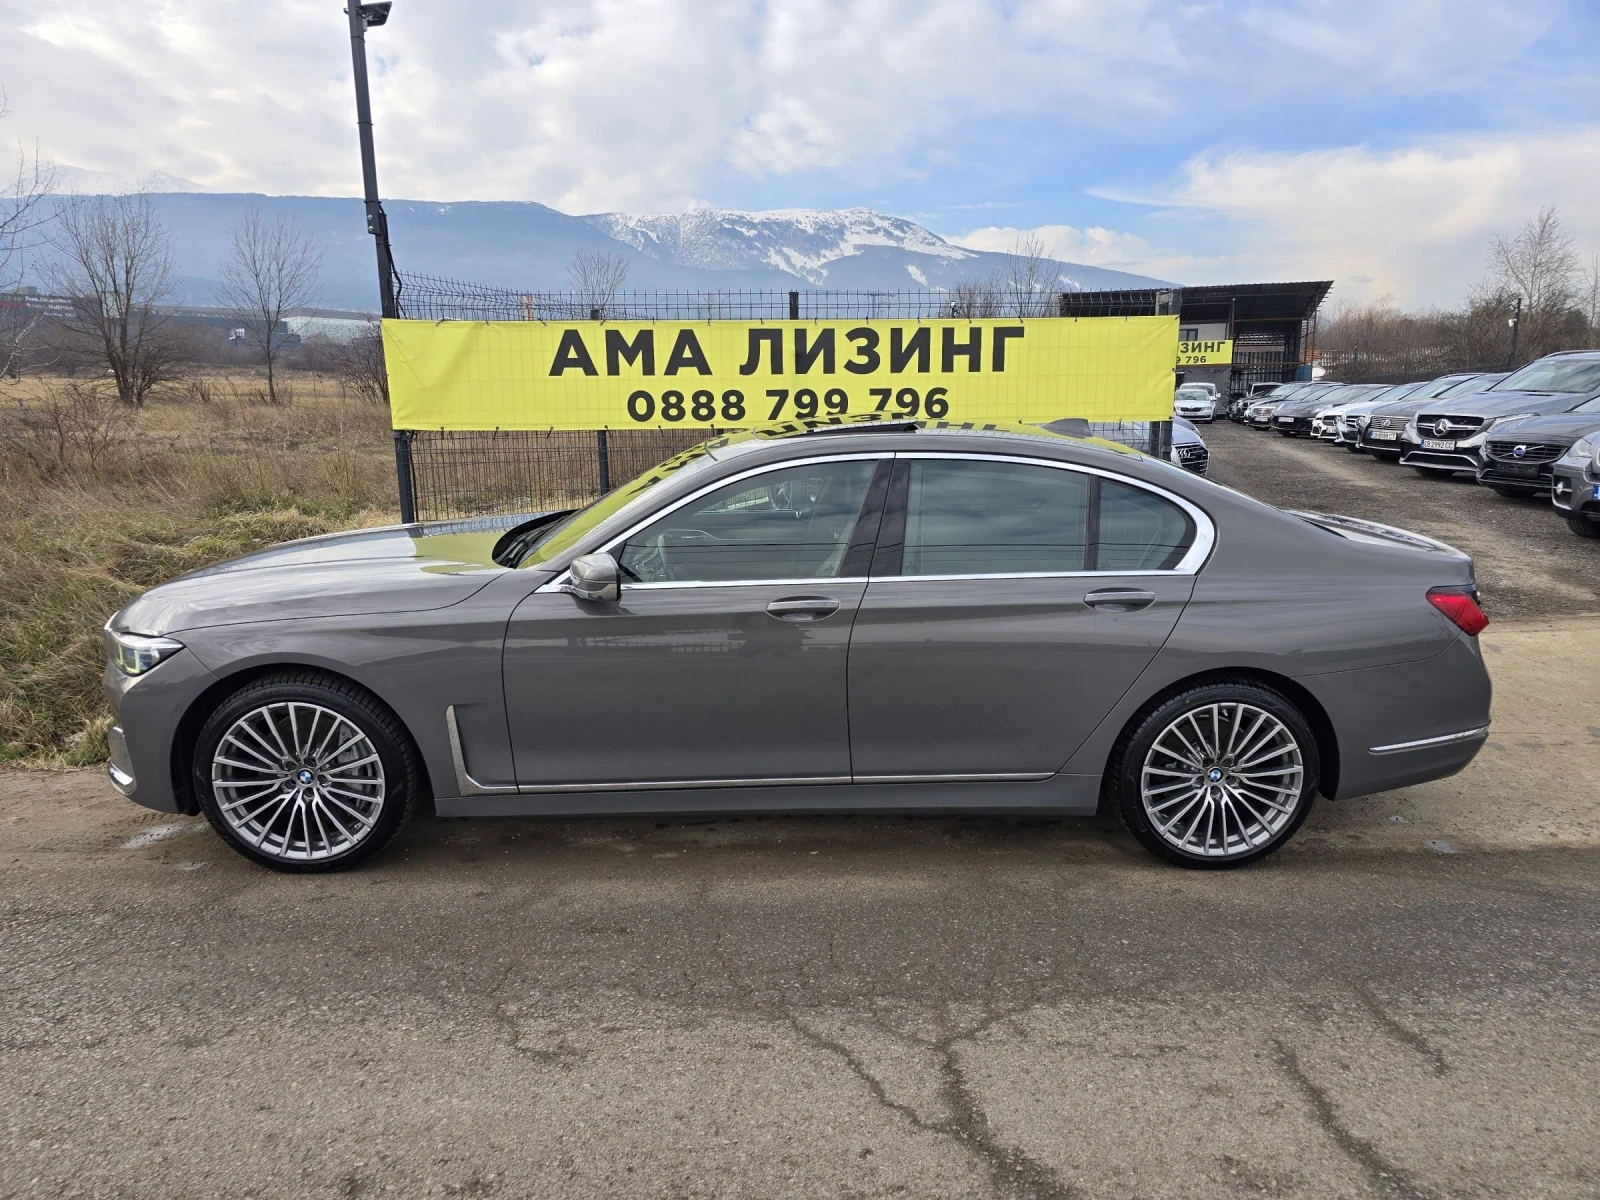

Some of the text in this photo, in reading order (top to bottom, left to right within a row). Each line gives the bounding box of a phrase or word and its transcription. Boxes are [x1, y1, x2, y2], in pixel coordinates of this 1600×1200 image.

[549, 326, 1025, 377] АМА ЛИЗИНГ
[1180, 341, 1226, 354] ЗИНГ
[1185, 355, 1207, 364] 796
[627, 389, 746, 422] 0888
[765, 388, 849, 420] 799
[869, 387, 950, 419] 796
